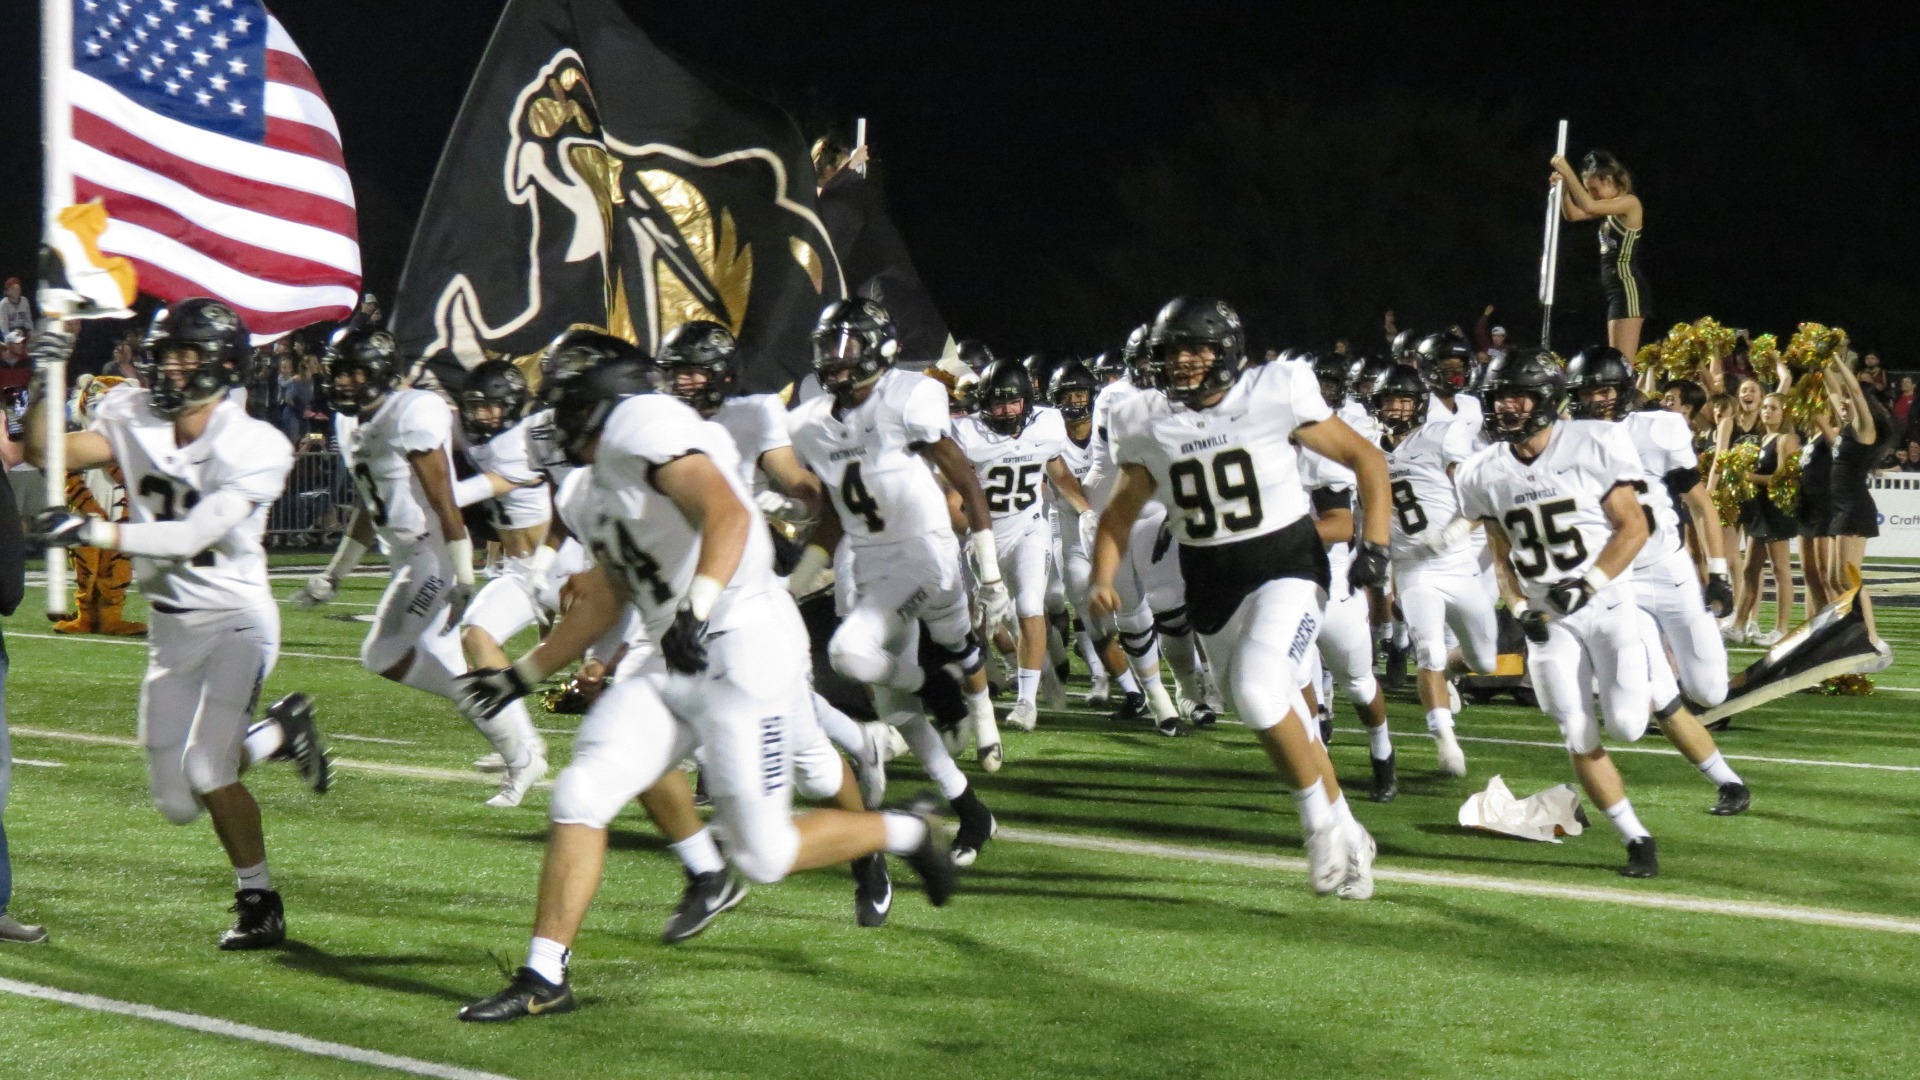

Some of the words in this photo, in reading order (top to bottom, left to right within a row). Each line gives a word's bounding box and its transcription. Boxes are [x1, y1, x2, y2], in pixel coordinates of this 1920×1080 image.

[842, 461, 885, 533] 4
[985, 463, 1043, 512] 25
[1169, 448, 1263, 539] 99
[1504, 499, 1588, 578] 35
[406, 575, 446, 618] TIGERS
[1288, 611, 1316, 665] TIGERS
